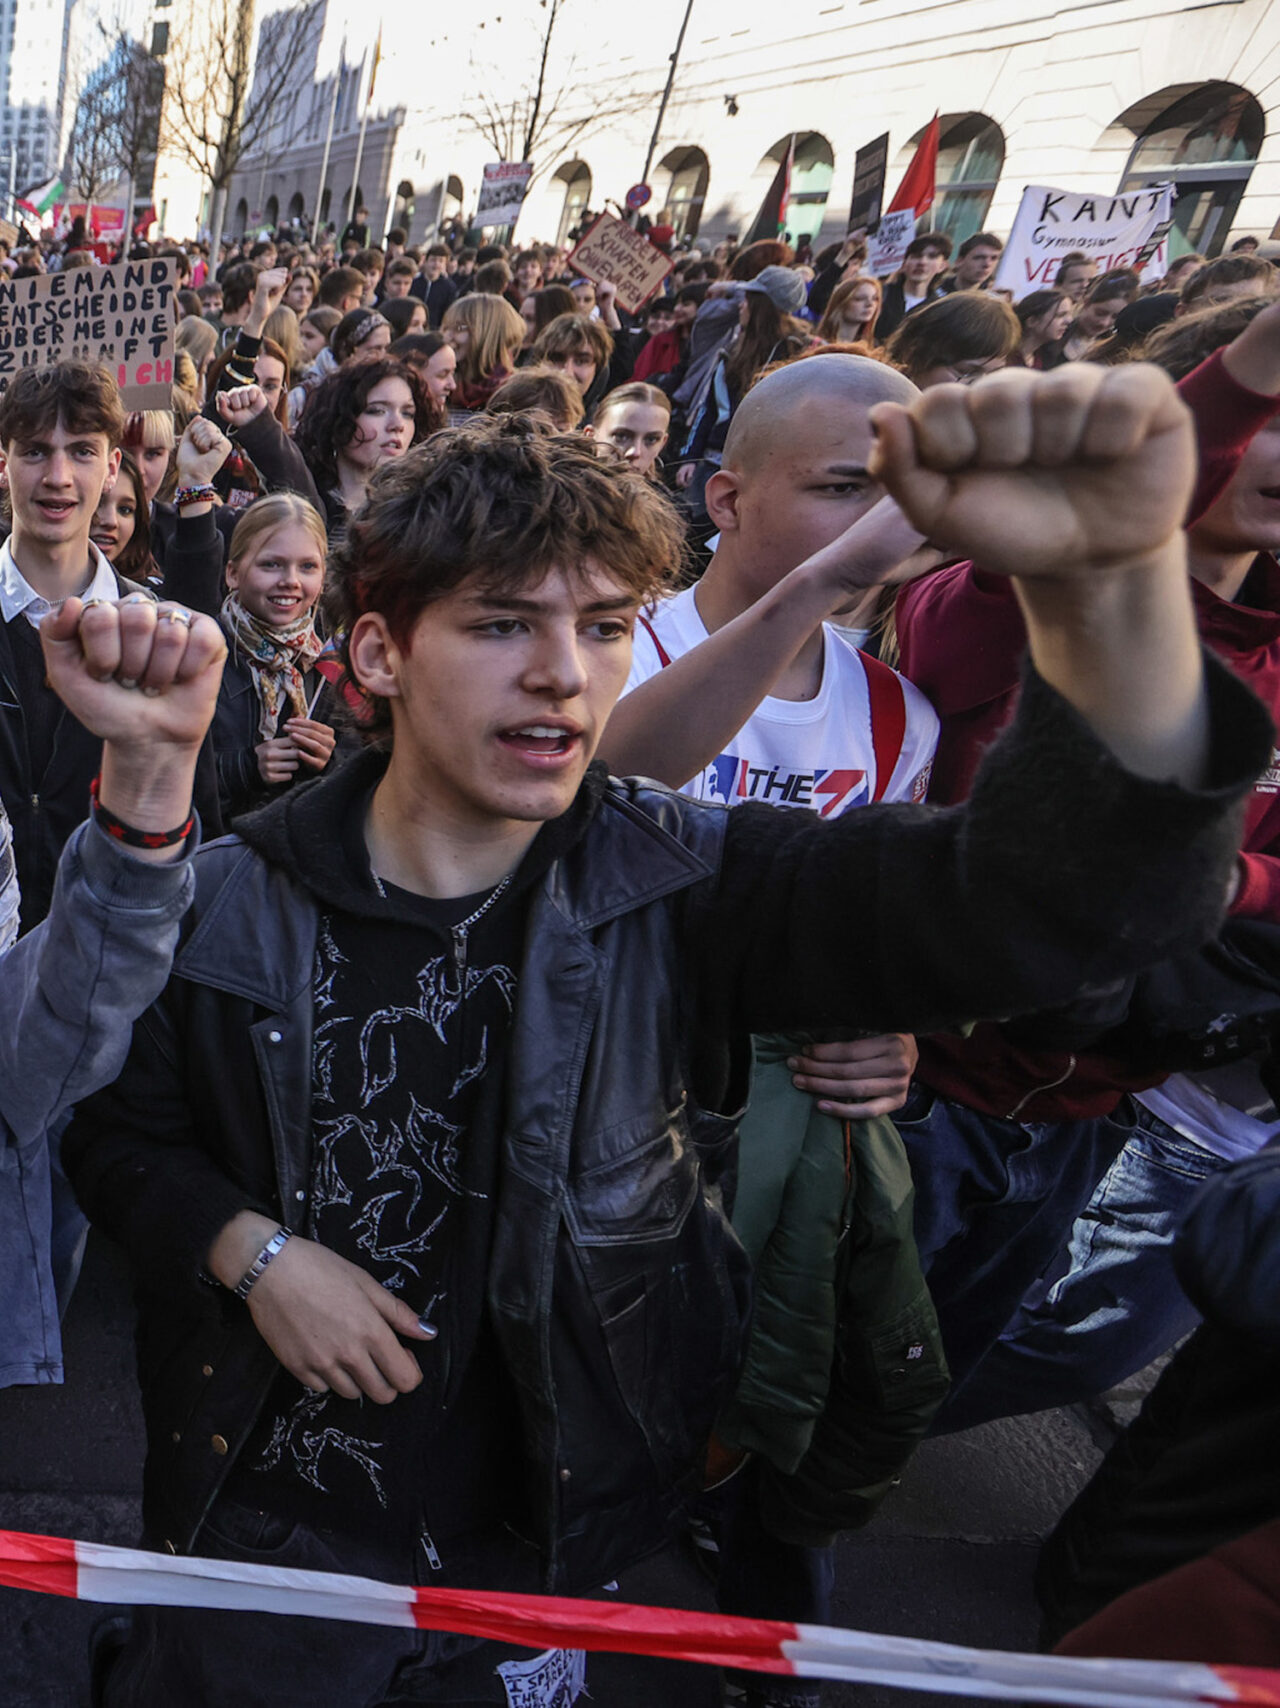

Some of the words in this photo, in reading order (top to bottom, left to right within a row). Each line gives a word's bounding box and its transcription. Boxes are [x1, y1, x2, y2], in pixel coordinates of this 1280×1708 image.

[1038, 190, 1167, 222] KANT
[604, 221, 662, 265] FRIEDEN
[1031, 225, 1120, 249] Gymnasium
[593, 232, 650, 282] SCHAFFEN
[73, 313, 168, 341] MEINE
[117, 359, 172, 388] ICH
[748, 766, 814, 804] THE
